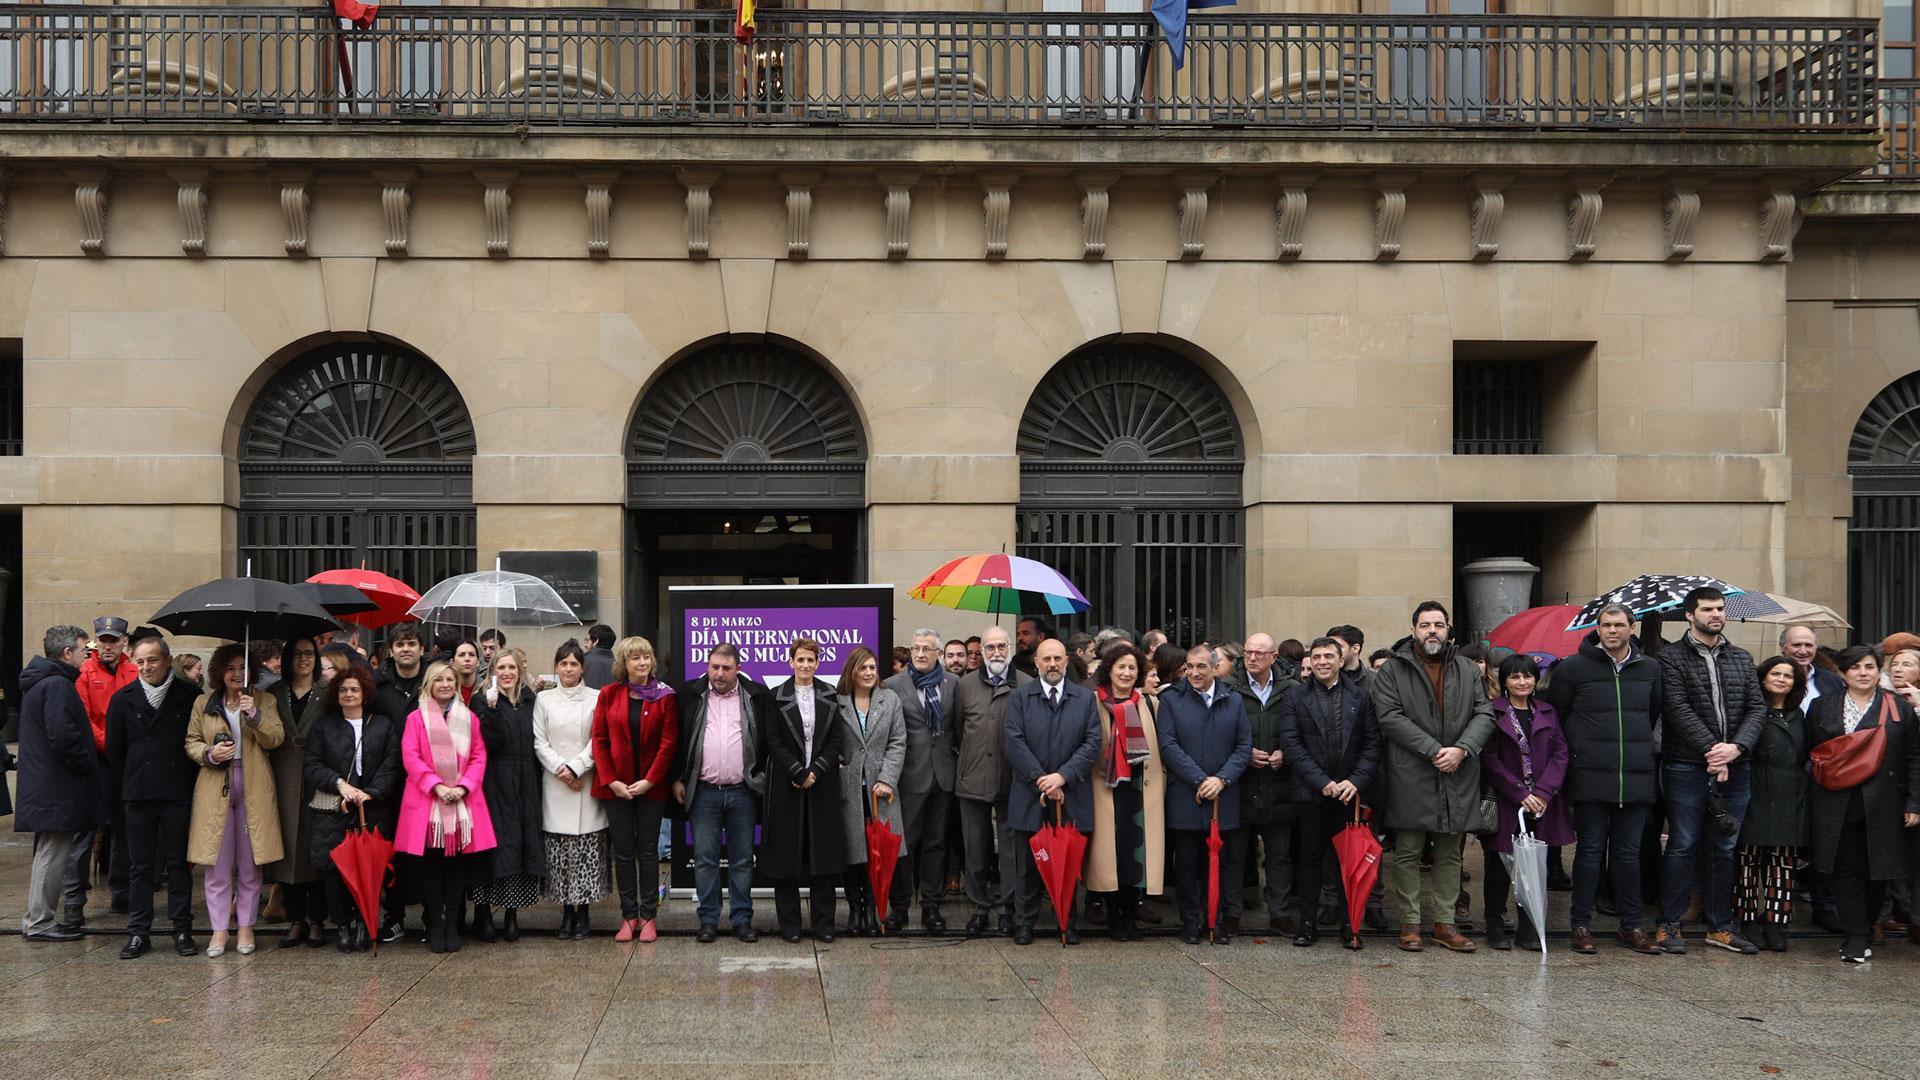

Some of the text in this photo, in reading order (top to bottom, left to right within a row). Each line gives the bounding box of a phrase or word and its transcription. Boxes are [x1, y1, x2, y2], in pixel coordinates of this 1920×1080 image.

[691, 616, 762, 627] 8 DE MARZO
[691, 627, 863, 645] DÍA INTERNACIONAL
